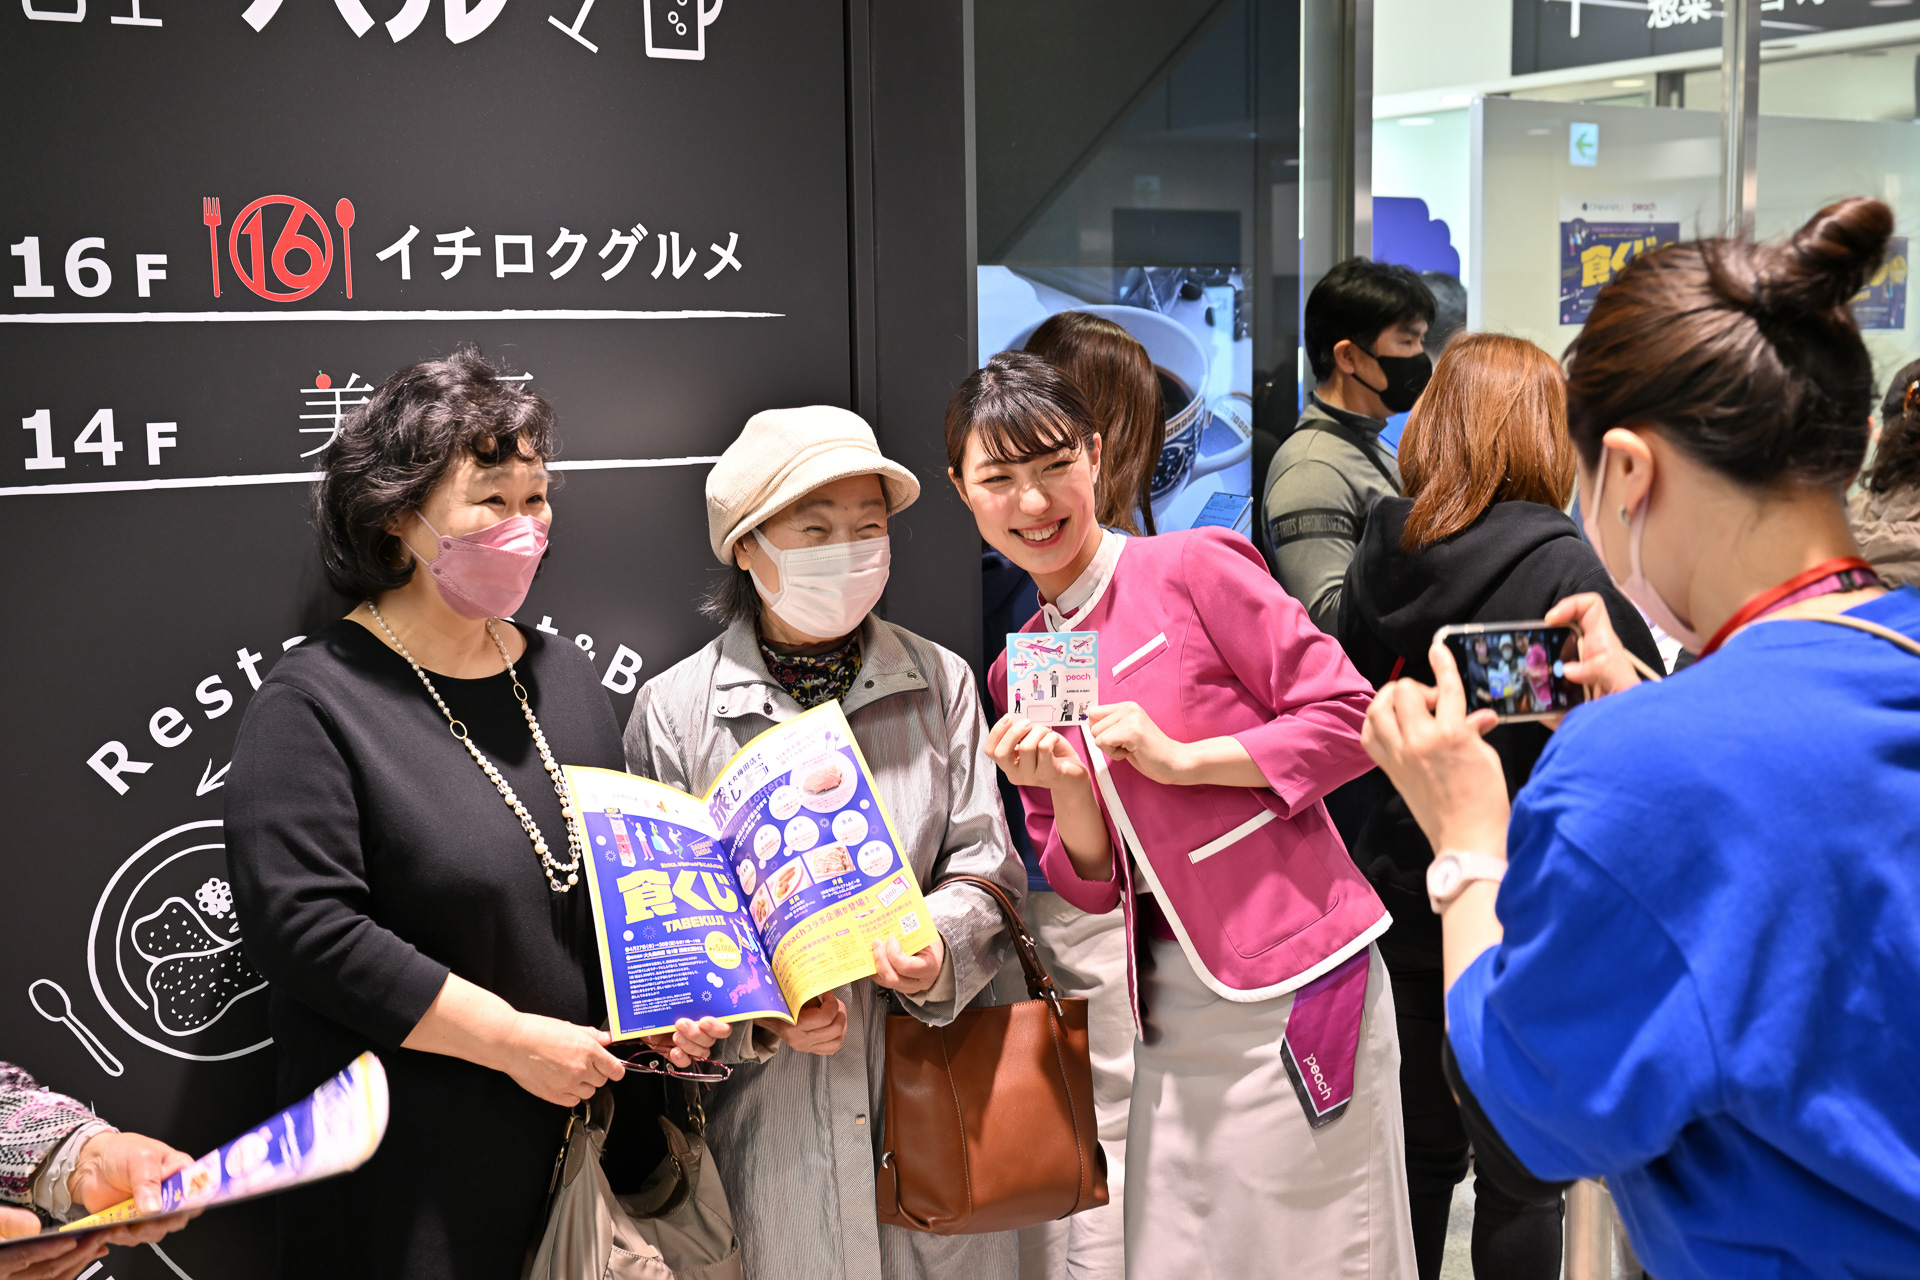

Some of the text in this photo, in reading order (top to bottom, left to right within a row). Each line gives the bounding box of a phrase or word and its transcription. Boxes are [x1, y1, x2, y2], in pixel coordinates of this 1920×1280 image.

[10, 236, 169, 298] 16 F
[374, 223, 744, 282] イチロクグルメ
[21, 408, 179, 471] 14 F
[1065, 672, 1091, 682] peach
[748, 774, 787, 808] Lottery
[615, 868, 739, 925] 食くじ
[661, 917, 727, 934] TABEKUJI
[1303, 1053, 1332, 1101] peach
